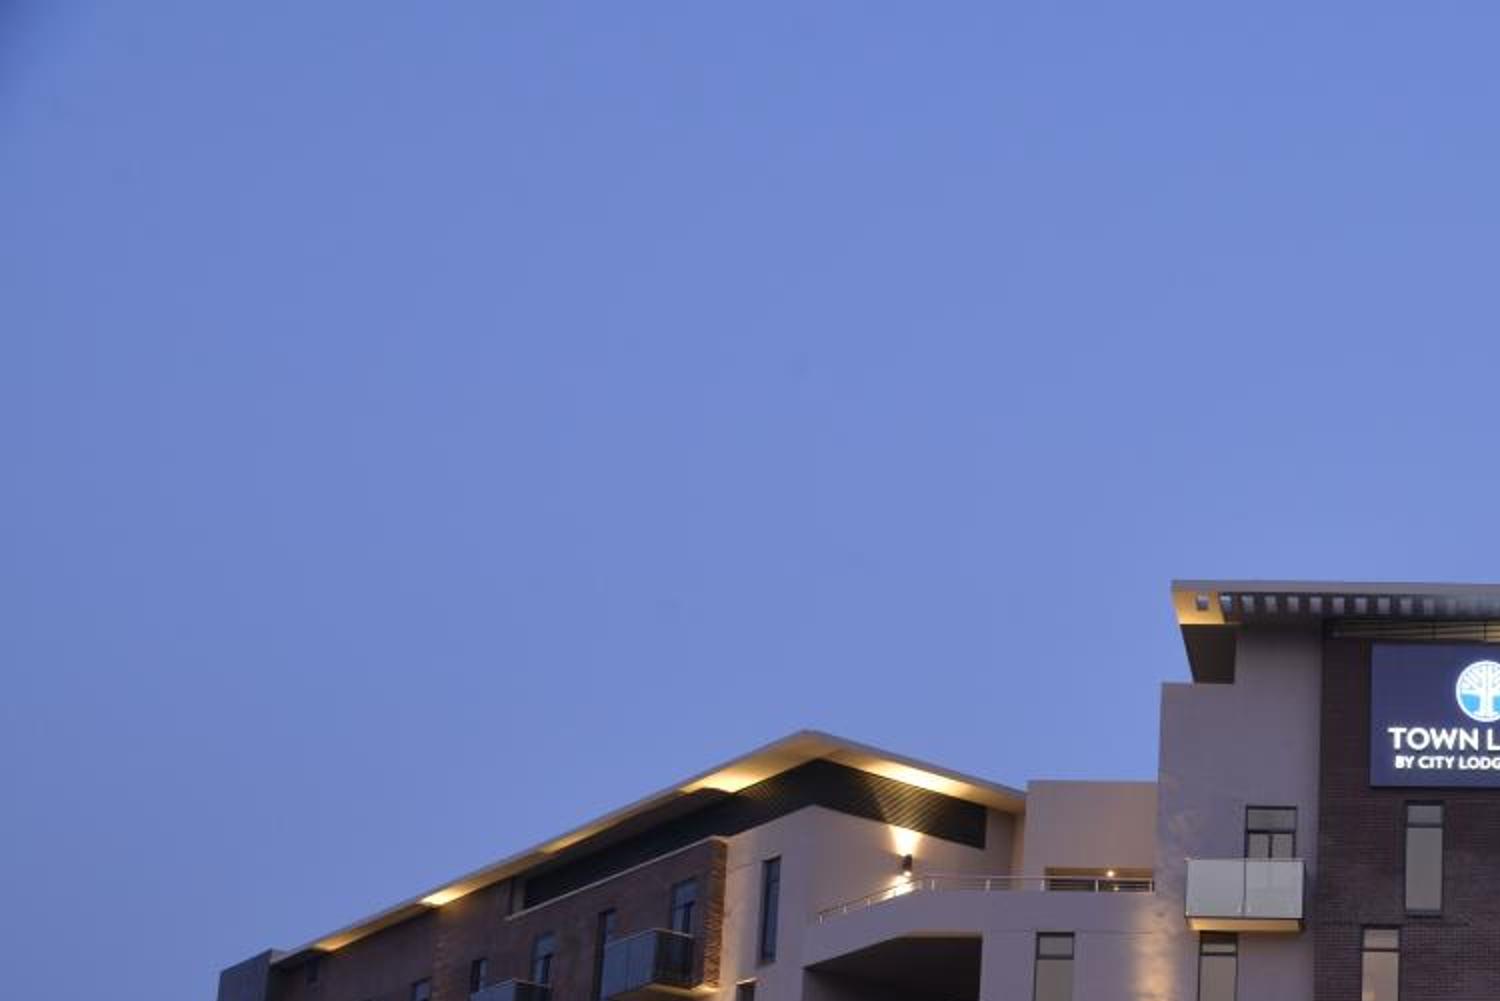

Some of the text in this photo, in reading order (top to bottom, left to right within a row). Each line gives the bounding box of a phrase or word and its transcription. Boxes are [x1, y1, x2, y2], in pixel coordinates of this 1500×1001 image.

[1387, 727, 1479, 751] TOWN
[1395, 755, 1415, 769] BY
[1418, 755, 1455, 769] CITY
